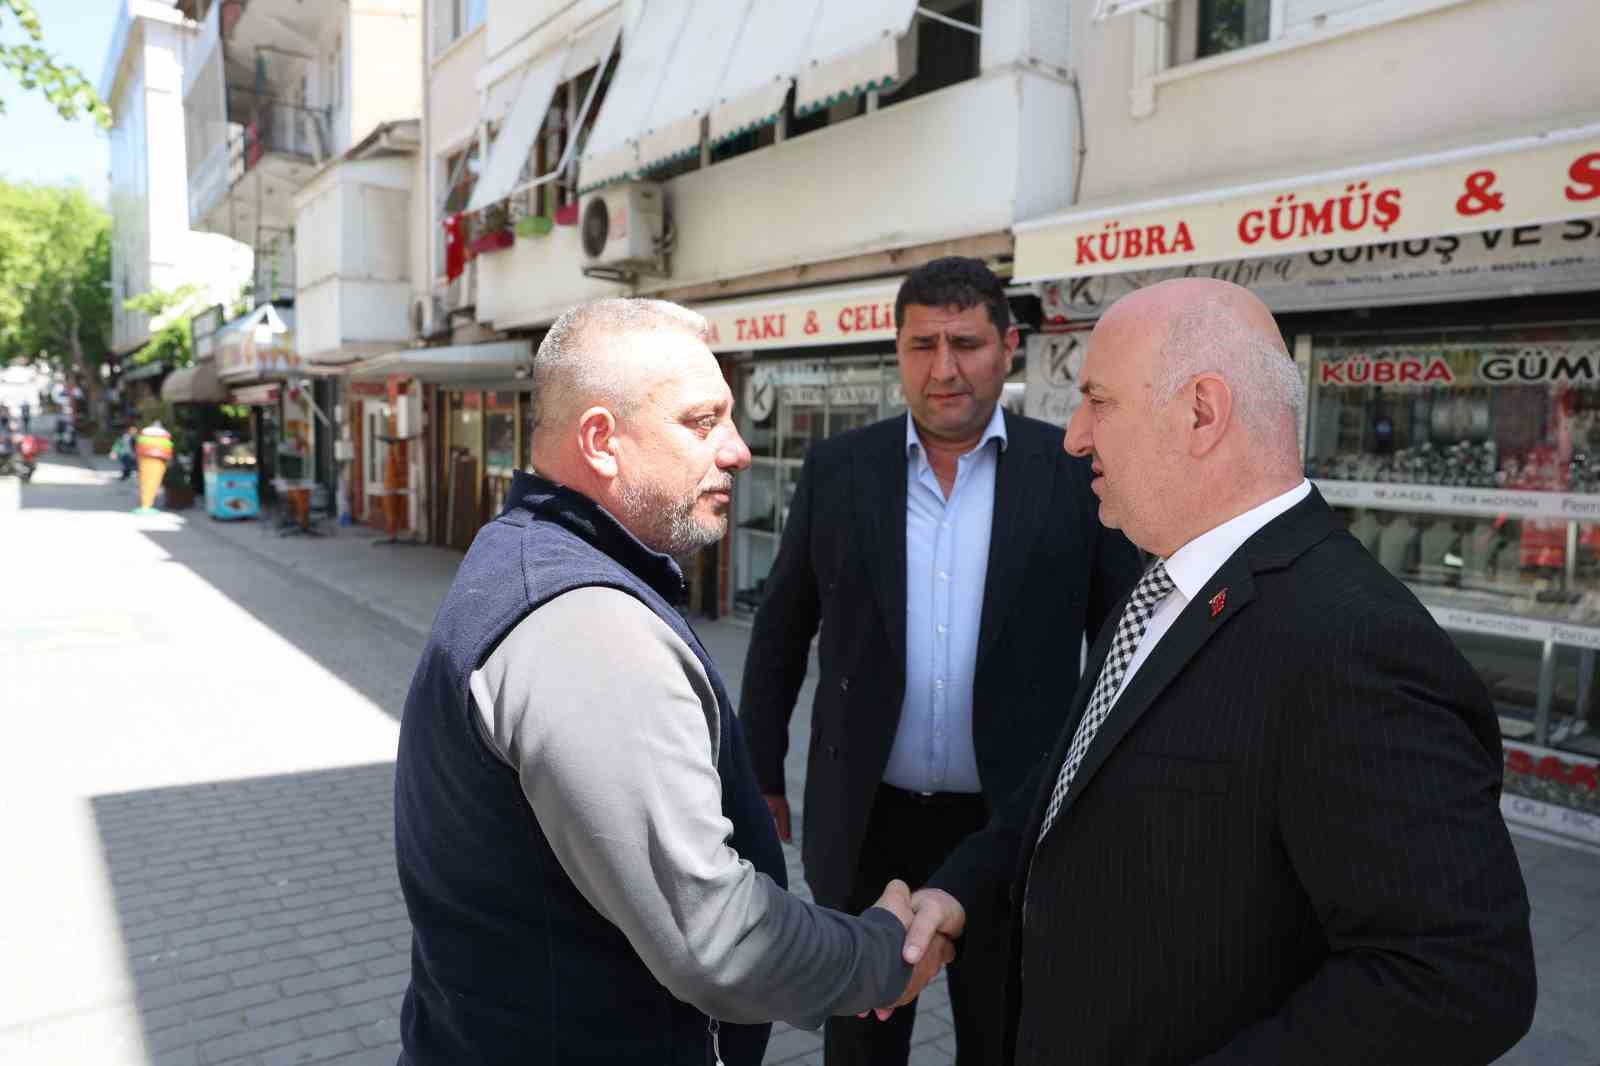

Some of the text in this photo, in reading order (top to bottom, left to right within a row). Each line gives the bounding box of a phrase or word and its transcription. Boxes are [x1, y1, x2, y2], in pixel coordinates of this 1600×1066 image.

[1074, 221, 1196, 265] KÜBRA
[1237, 181, 1403, 246] GÜMÜŞ
[1455, 169, 1505, 217] &
[1481, 222, 1542, 249] VE
[735, 313, 786, 341] TAKI
[804, 309, 820, 335] &
[1322, 354, 1453, 384] KÜBRA
